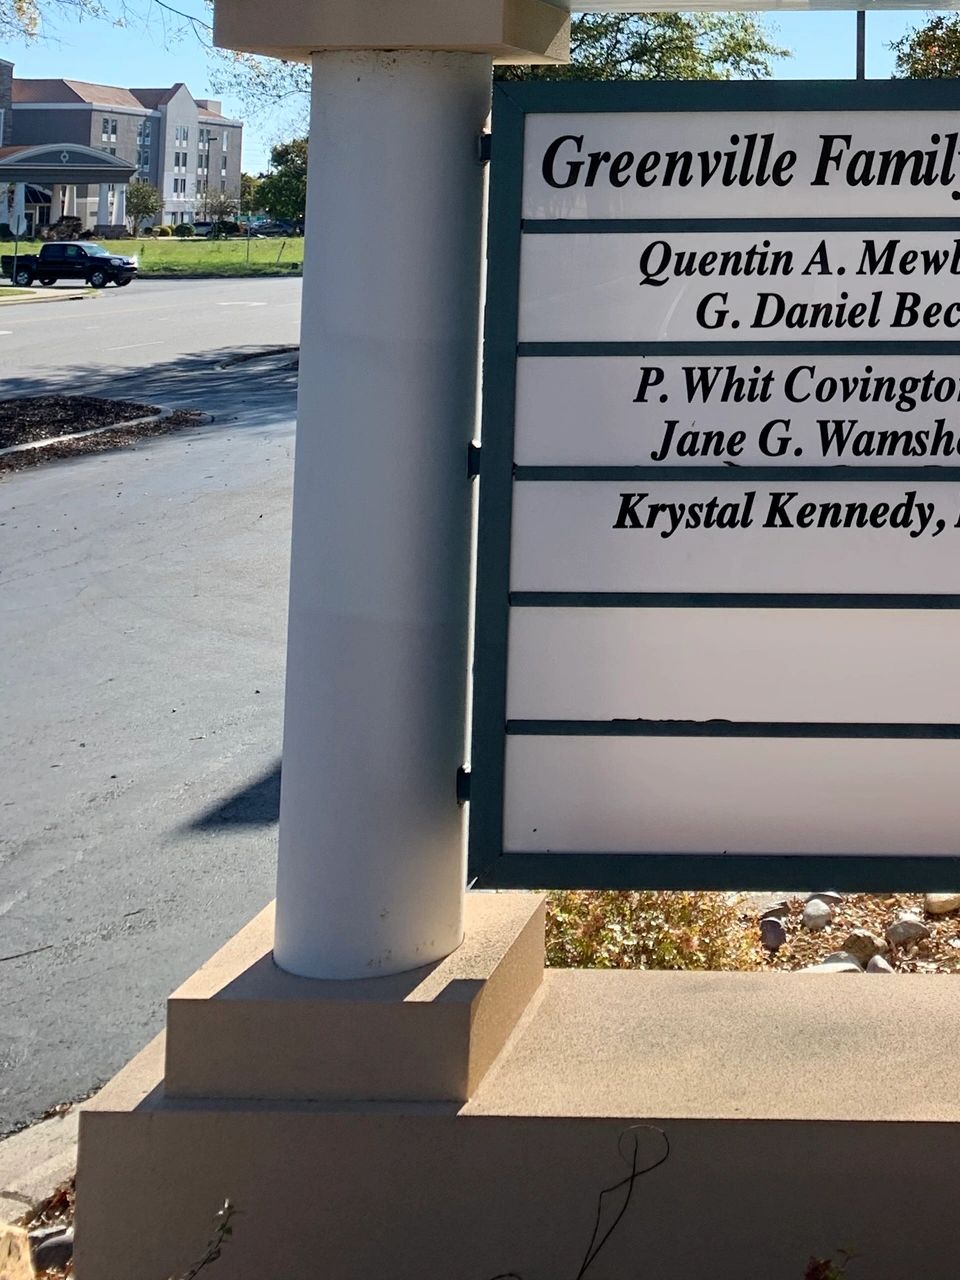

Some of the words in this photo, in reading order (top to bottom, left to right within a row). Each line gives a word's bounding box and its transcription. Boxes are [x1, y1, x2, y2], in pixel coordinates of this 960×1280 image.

[542, 133, 797, 188] Greenville
[639, 240, 793, 286] Quentin
[802, 239, 846, 276] A.
[696, 292, 740, 329] G.
[750, 291, 882, 328] Daniel
[633, 367, 668, 403] P.
[681, 365, 774, 403] Whit
[650, 420, 746, 461] Jane
[758, 419, 803, 457] G.
[612, 491, 756, 538] Krystal
[762, 491, 946, 537] Kennedy,
